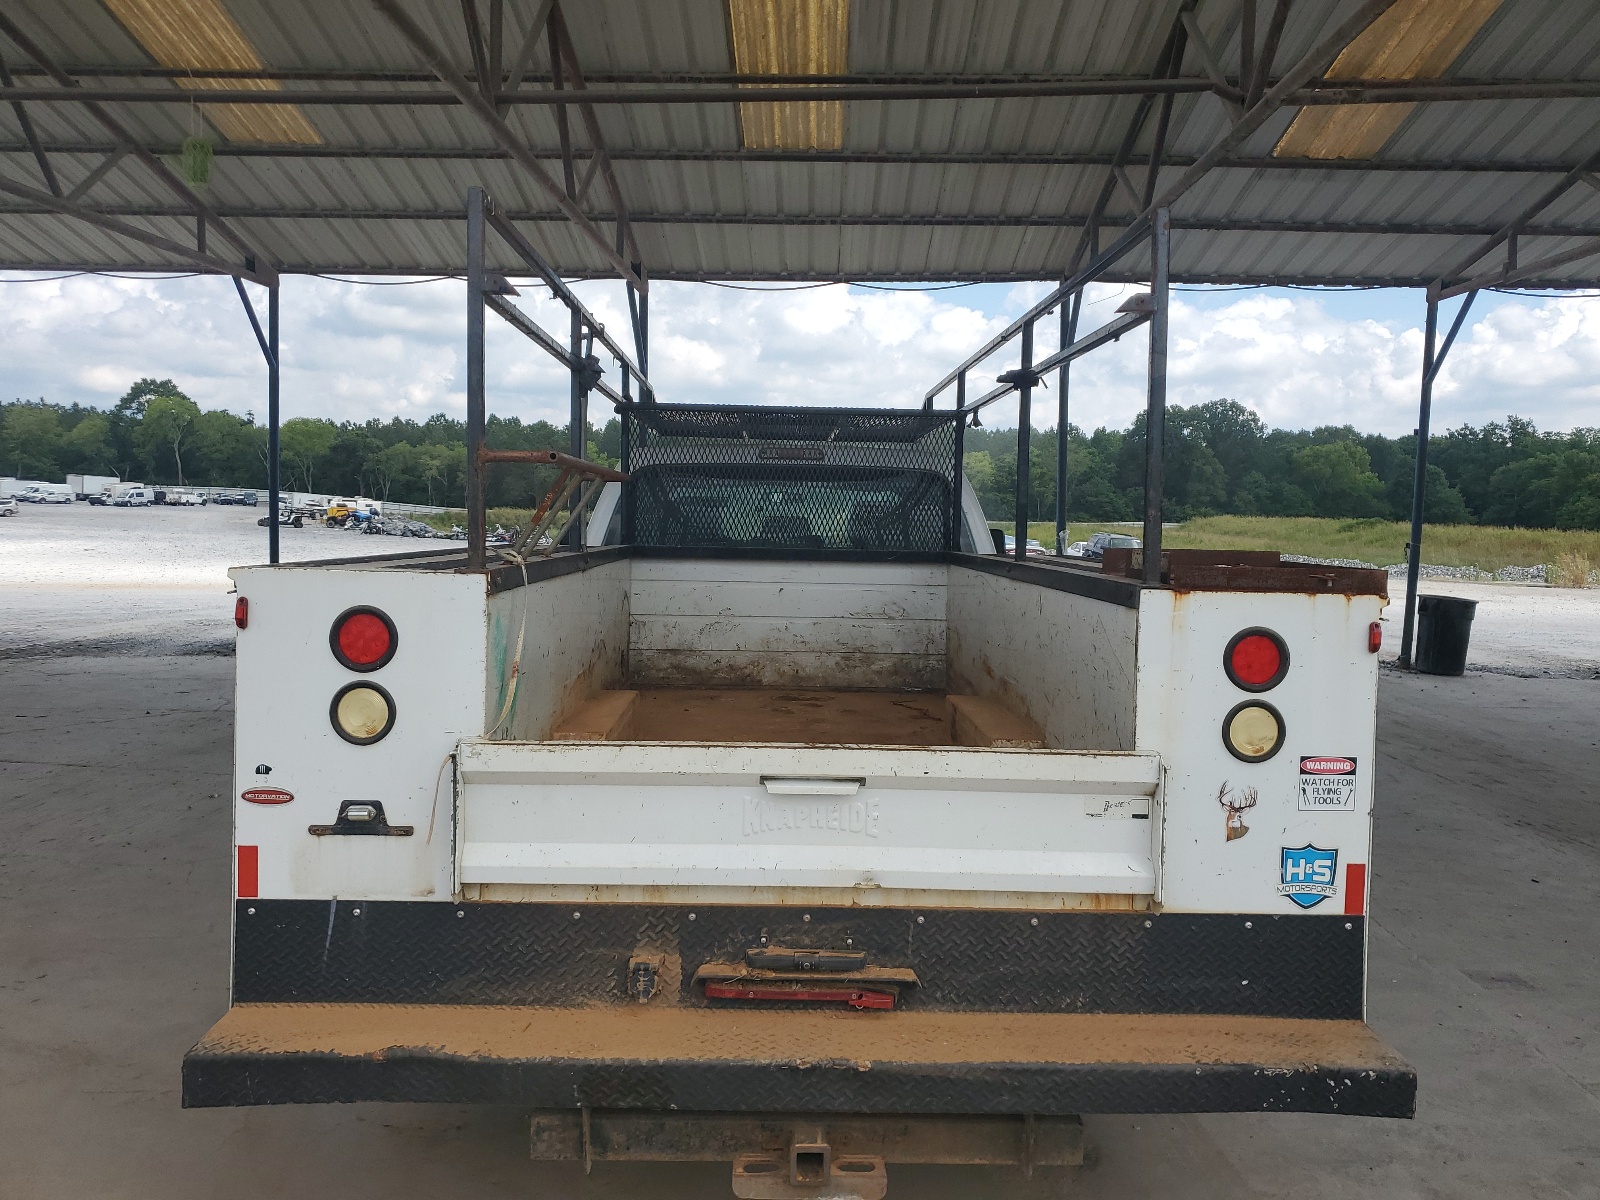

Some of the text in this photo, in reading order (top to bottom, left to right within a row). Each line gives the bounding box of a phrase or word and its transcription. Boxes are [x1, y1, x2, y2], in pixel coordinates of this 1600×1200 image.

[1306, 761, 1351, 770] WARNING
[1301, 778, 1354, 787] WATCH FOR
[1312, 787, 1342, 796] FLYING
[1312, 796, 1341, 805] TOOLS
[742, 795, 880, 839] KNAPHEIDE
[1286, 858, 1332, 882] H&S
[1276, 884, 1338, 896] MOTORSPORTS
